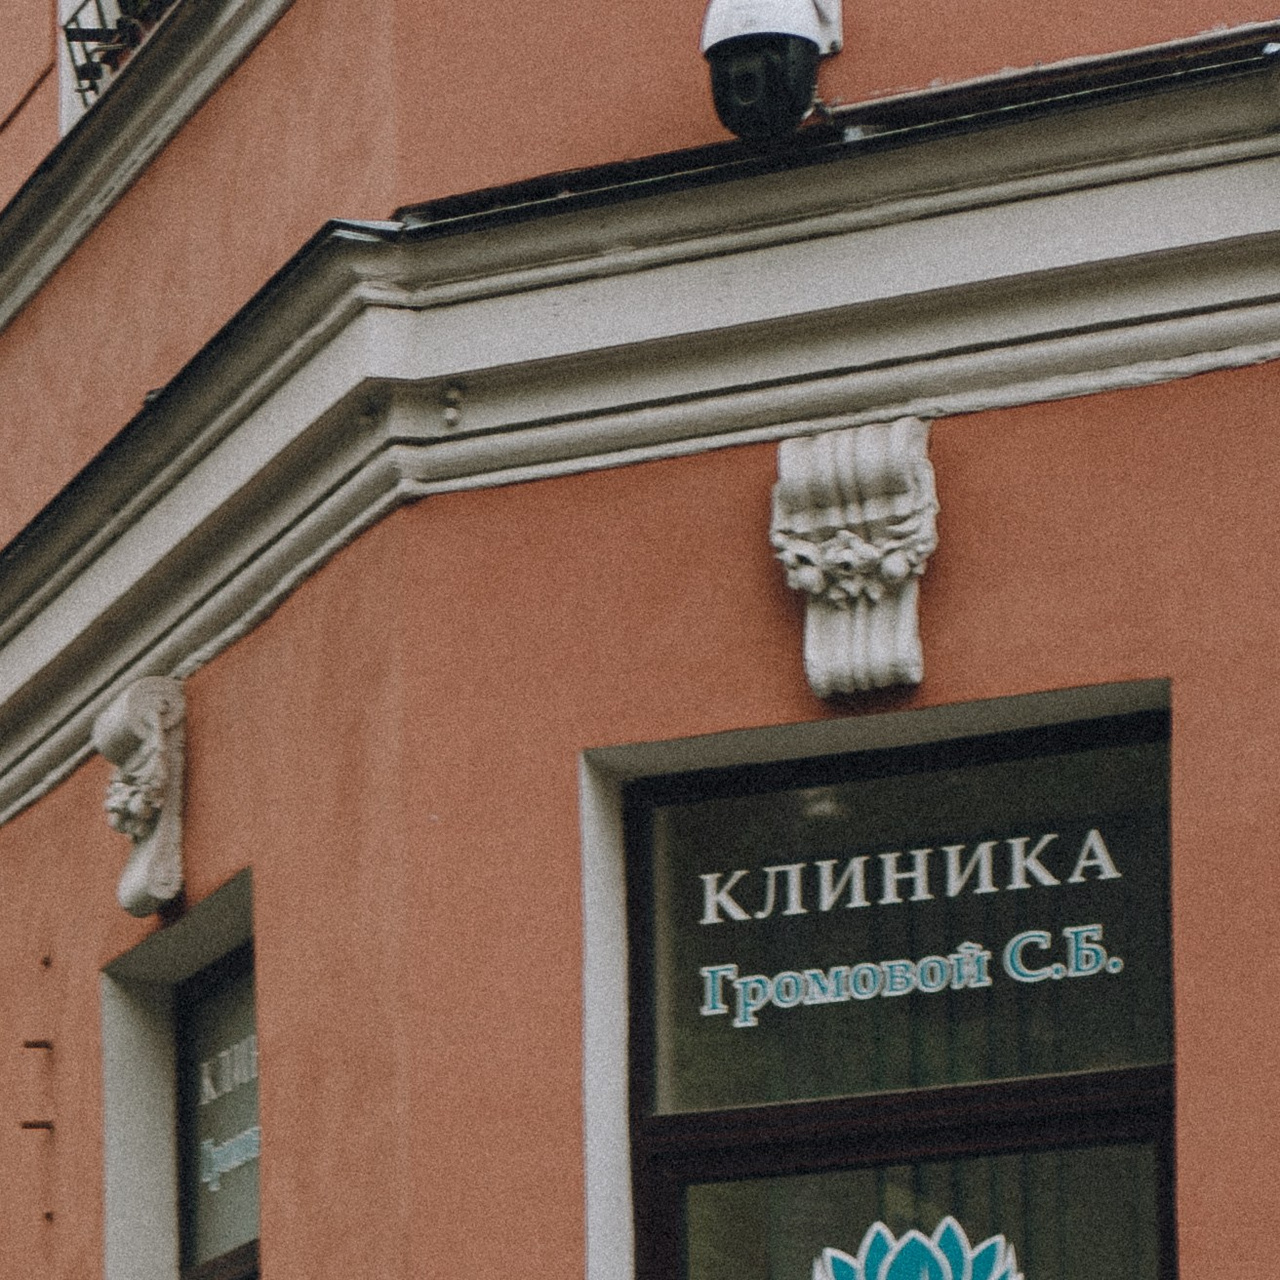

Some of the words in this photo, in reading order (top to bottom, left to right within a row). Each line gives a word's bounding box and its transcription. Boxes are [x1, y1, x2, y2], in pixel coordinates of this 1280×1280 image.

[698, 828, 1122, 926] КЛИНИКА
[700, 941, 994, 1027] Громовой
[1003, 924, 1124, 985] С.Б.
